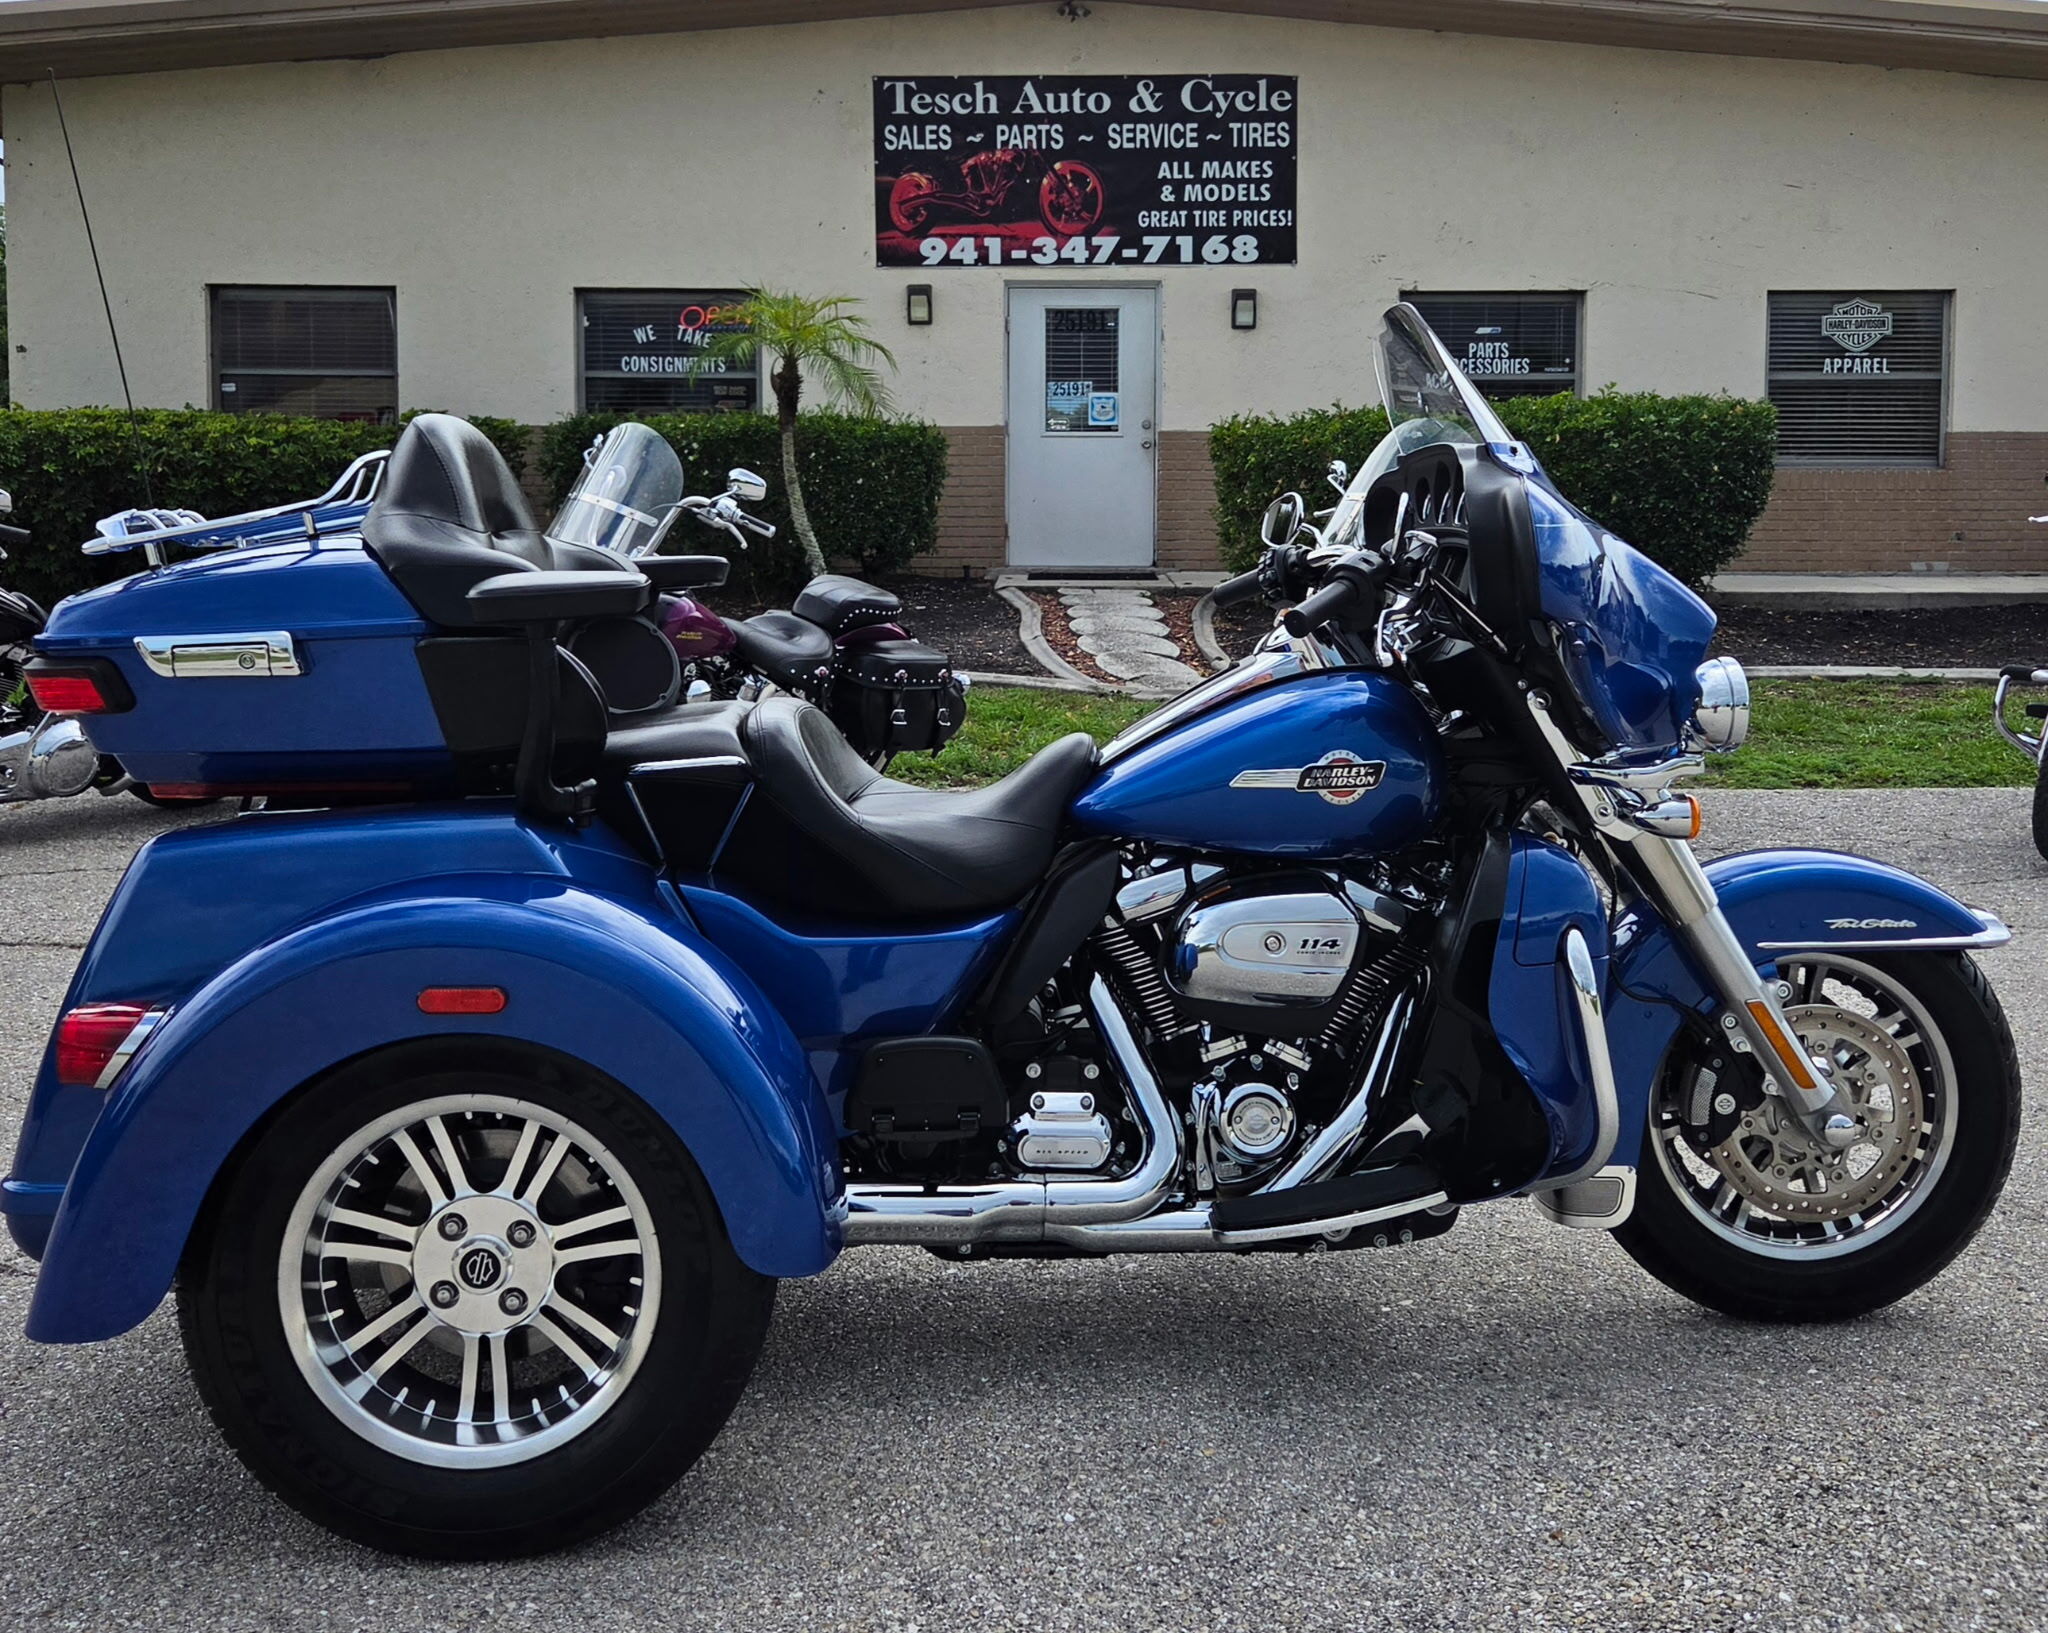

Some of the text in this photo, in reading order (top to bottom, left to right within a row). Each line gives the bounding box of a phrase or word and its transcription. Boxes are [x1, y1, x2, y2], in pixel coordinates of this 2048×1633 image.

[884, 78, 1292, 119] Tesch Auto & Cycle
[884, 124, 952, 150] SALES
[996, 124, 1063, 150] PARTS
[1107, 123, 1198, 149] SERVICE
[1229, 122, 1290, 148] TIRES
[1157, 160, 1273, 179] ALL MAKES
[1160, 183, 1271, 202] & MODELS
[1138, 209, 1292, 227] GREAT TIRE PRICES!
[919, 235, 1259, 265] 941-347-7168
[1842, 305, 1873, 316] MOTOR
[633, 324, 712, 348] WE TAKE
[1842, 332, 1872, 346] CYCLES
[1469, 342, 1509, 358] PARTS
[1823, 358, 1890, 374] APPAREL
[1053, 382, 1085, 396] 25191
[1303, 775, 1376, 787] DAVIDSON
[1300, 938, 1341, 949] 114
